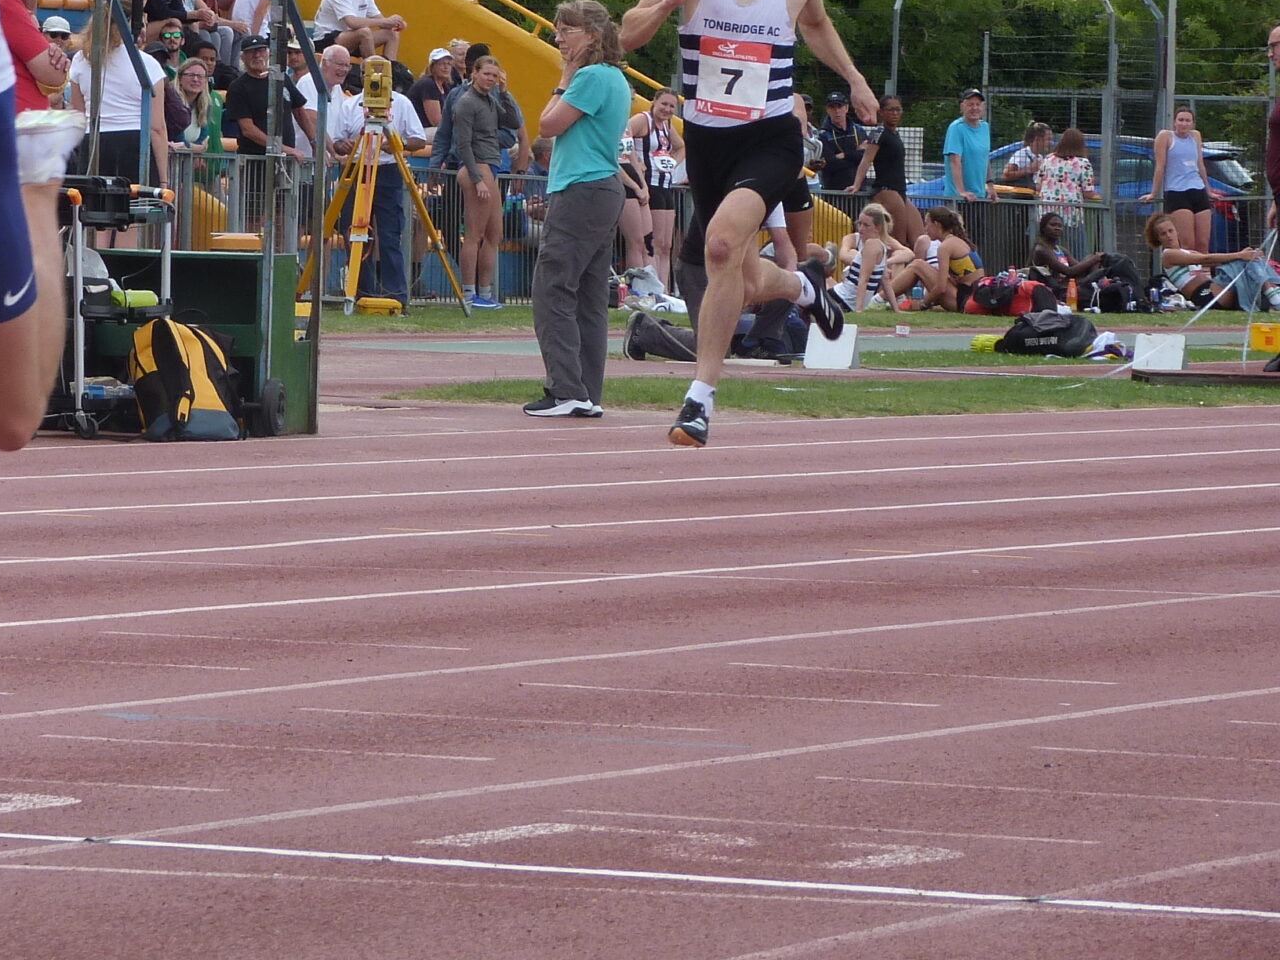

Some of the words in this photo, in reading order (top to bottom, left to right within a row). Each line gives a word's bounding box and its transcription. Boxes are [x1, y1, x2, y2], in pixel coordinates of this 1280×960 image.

[703, 18, 765, 35] TONBRIDGE
[766, 26, 781, 37] AC
[720, 68, 744, 95] 7
[660, 159, 674, 169] 55
